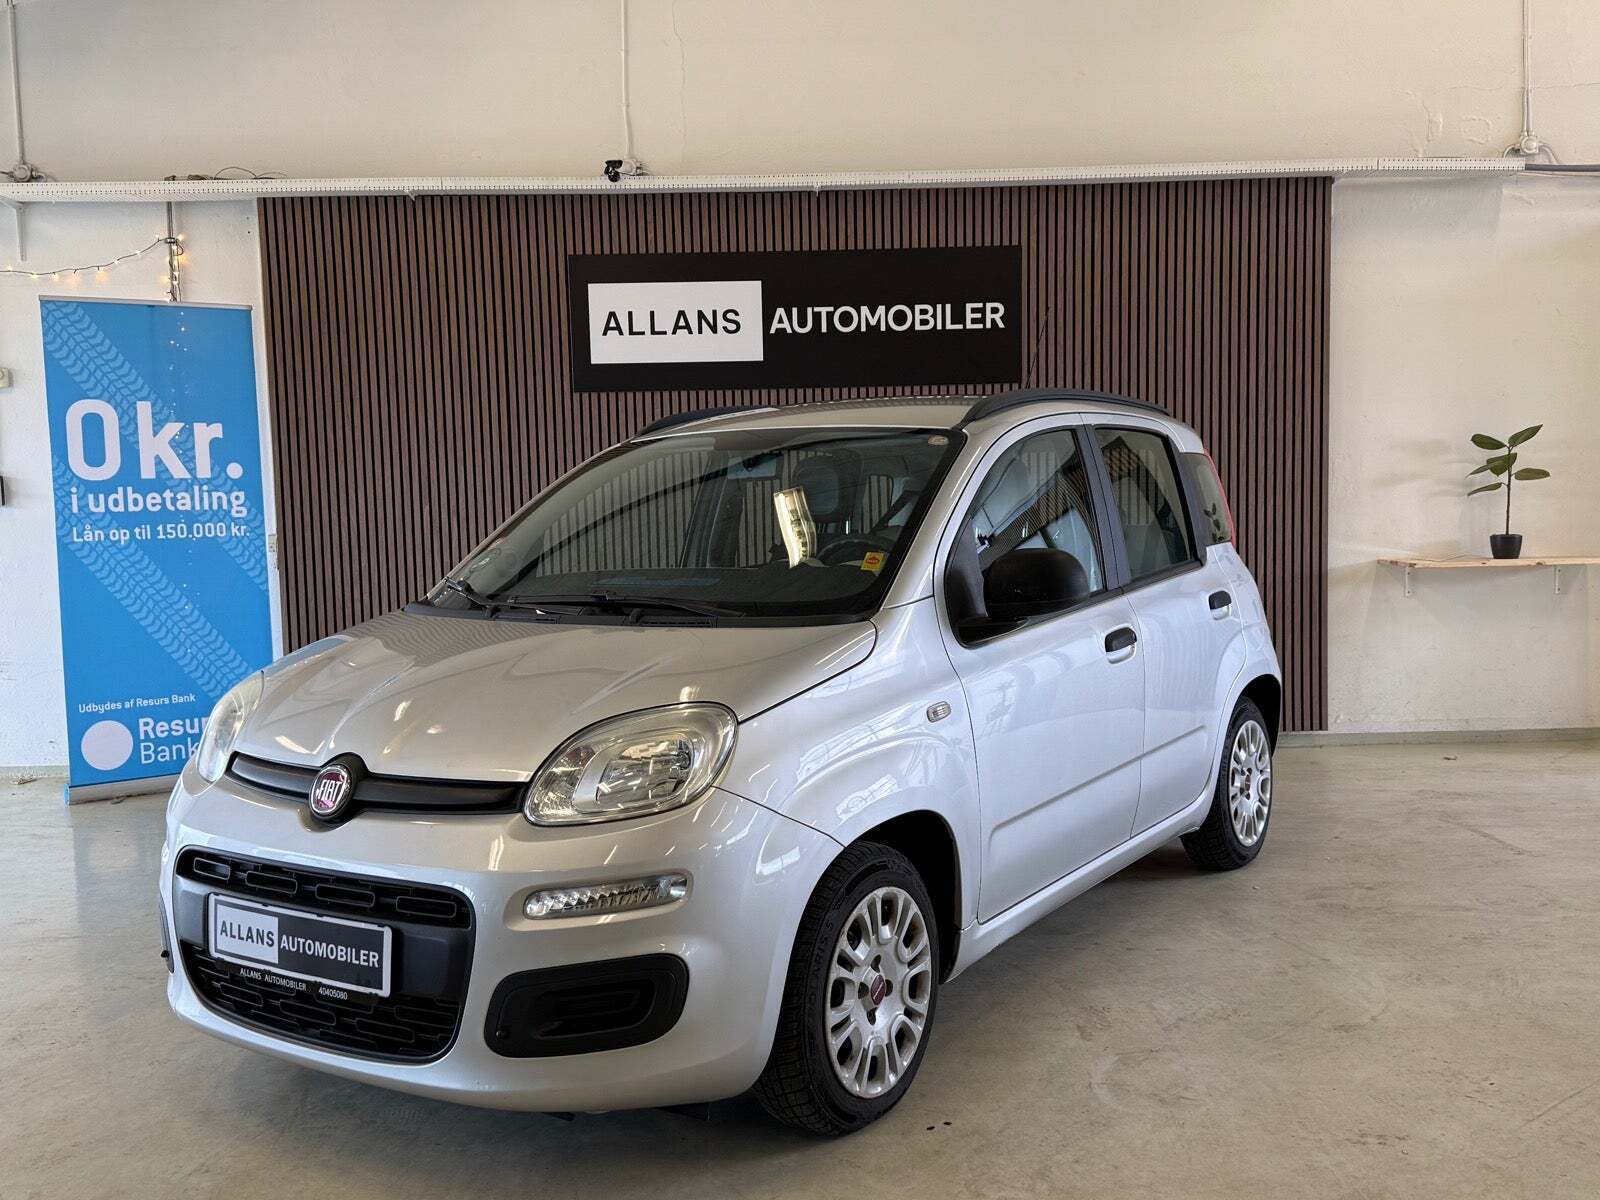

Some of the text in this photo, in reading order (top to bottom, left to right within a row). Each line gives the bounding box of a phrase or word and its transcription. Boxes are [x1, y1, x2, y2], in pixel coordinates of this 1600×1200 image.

[602, 302, 1006, 336] ALLANS AUTOMOBILER
[65, 398, 243, 481] 0 kr.
[70, 485, 248, 518] i udbetaling
[72, 521, 250, 545] Lån op til 150.000 kr.
[78, 692, 196, 714] Udbydes af Resurs Bank
[138, 716, 209, 740] Resur
[317, 779, 343, 802] FIAT
[219, 919, 380, 969] ALLANS AUTOMOBILER
[240, 967, 262, 981] ALLANS
[264, 974, 307, 992] AUTOMOBILER
